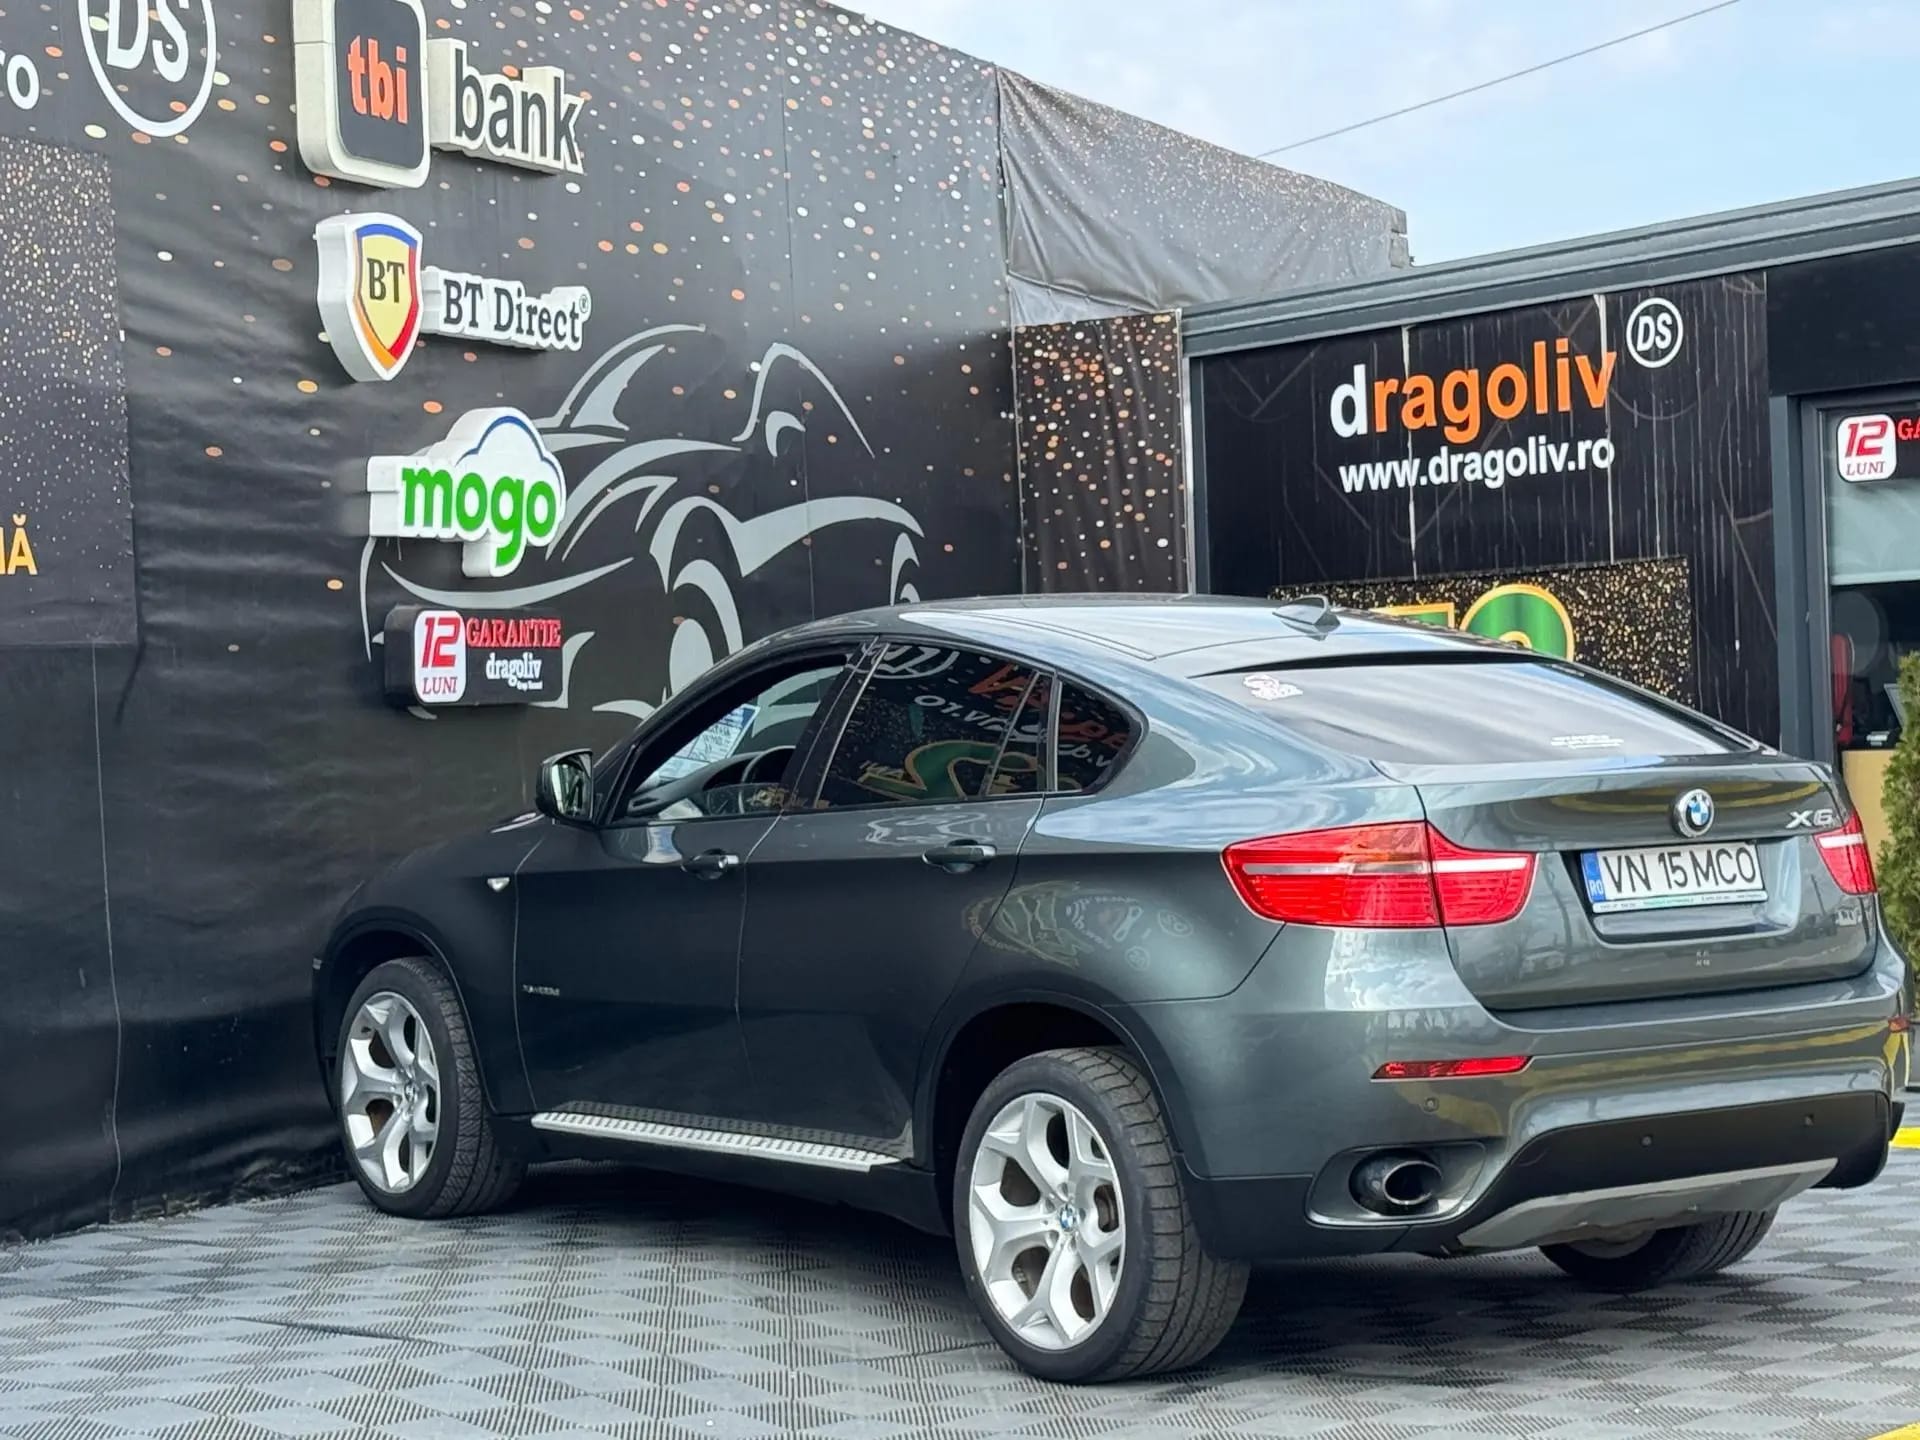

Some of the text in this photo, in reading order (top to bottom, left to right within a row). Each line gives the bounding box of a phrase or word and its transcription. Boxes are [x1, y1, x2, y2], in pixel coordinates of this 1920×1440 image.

[0, 51, 40, 110] o
[347, 34, 408, 125] tbi
[455, 47, 579, 166] bank
[366, 257, 405, 303] BT
[443, 278, 484, 328] BT
[1636, 312, 1673, 352] DS
[1329, 337, 1617, 444] dragoliv
[1845, 420, 1888, 458] 12
[1339, 436, 1615, 494] www.dragoliv.ro
[1846, 461, 1885, 476] LUNI
[402, 467, 557, 567] mogo
[421, 617, 461, 668] 12
[466, 616, 561, 648] GARANTIE
[422, 676, 458, 695] LUNI
[486, 652, 542, 687] dragoliv
[1785, 808, 1833, 829] X6
[1603, 847, 1757, 893] VN 15 MCO
